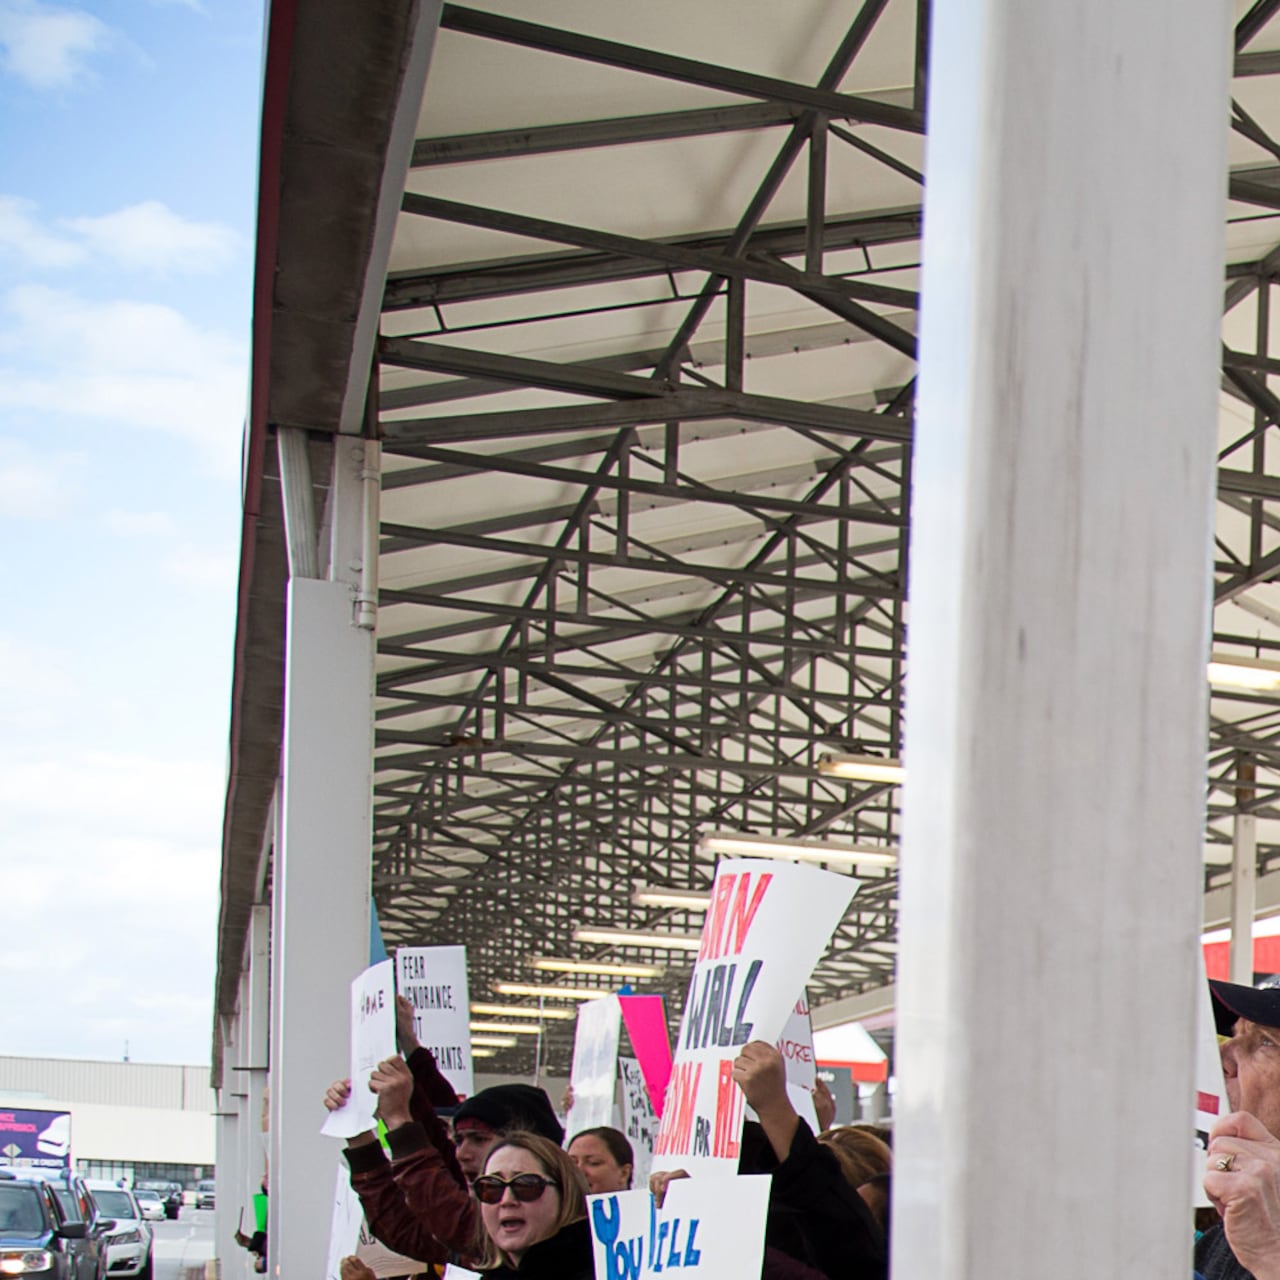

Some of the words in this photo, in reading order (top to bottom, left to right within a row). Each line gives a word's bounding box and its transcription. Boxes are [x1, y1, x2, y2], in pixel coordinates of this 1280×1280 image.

[403, 955, 425, 979] FEAR
[685, 959, 764, 1050] WALL
[429, 1046, 467, 1071] RANTS.
